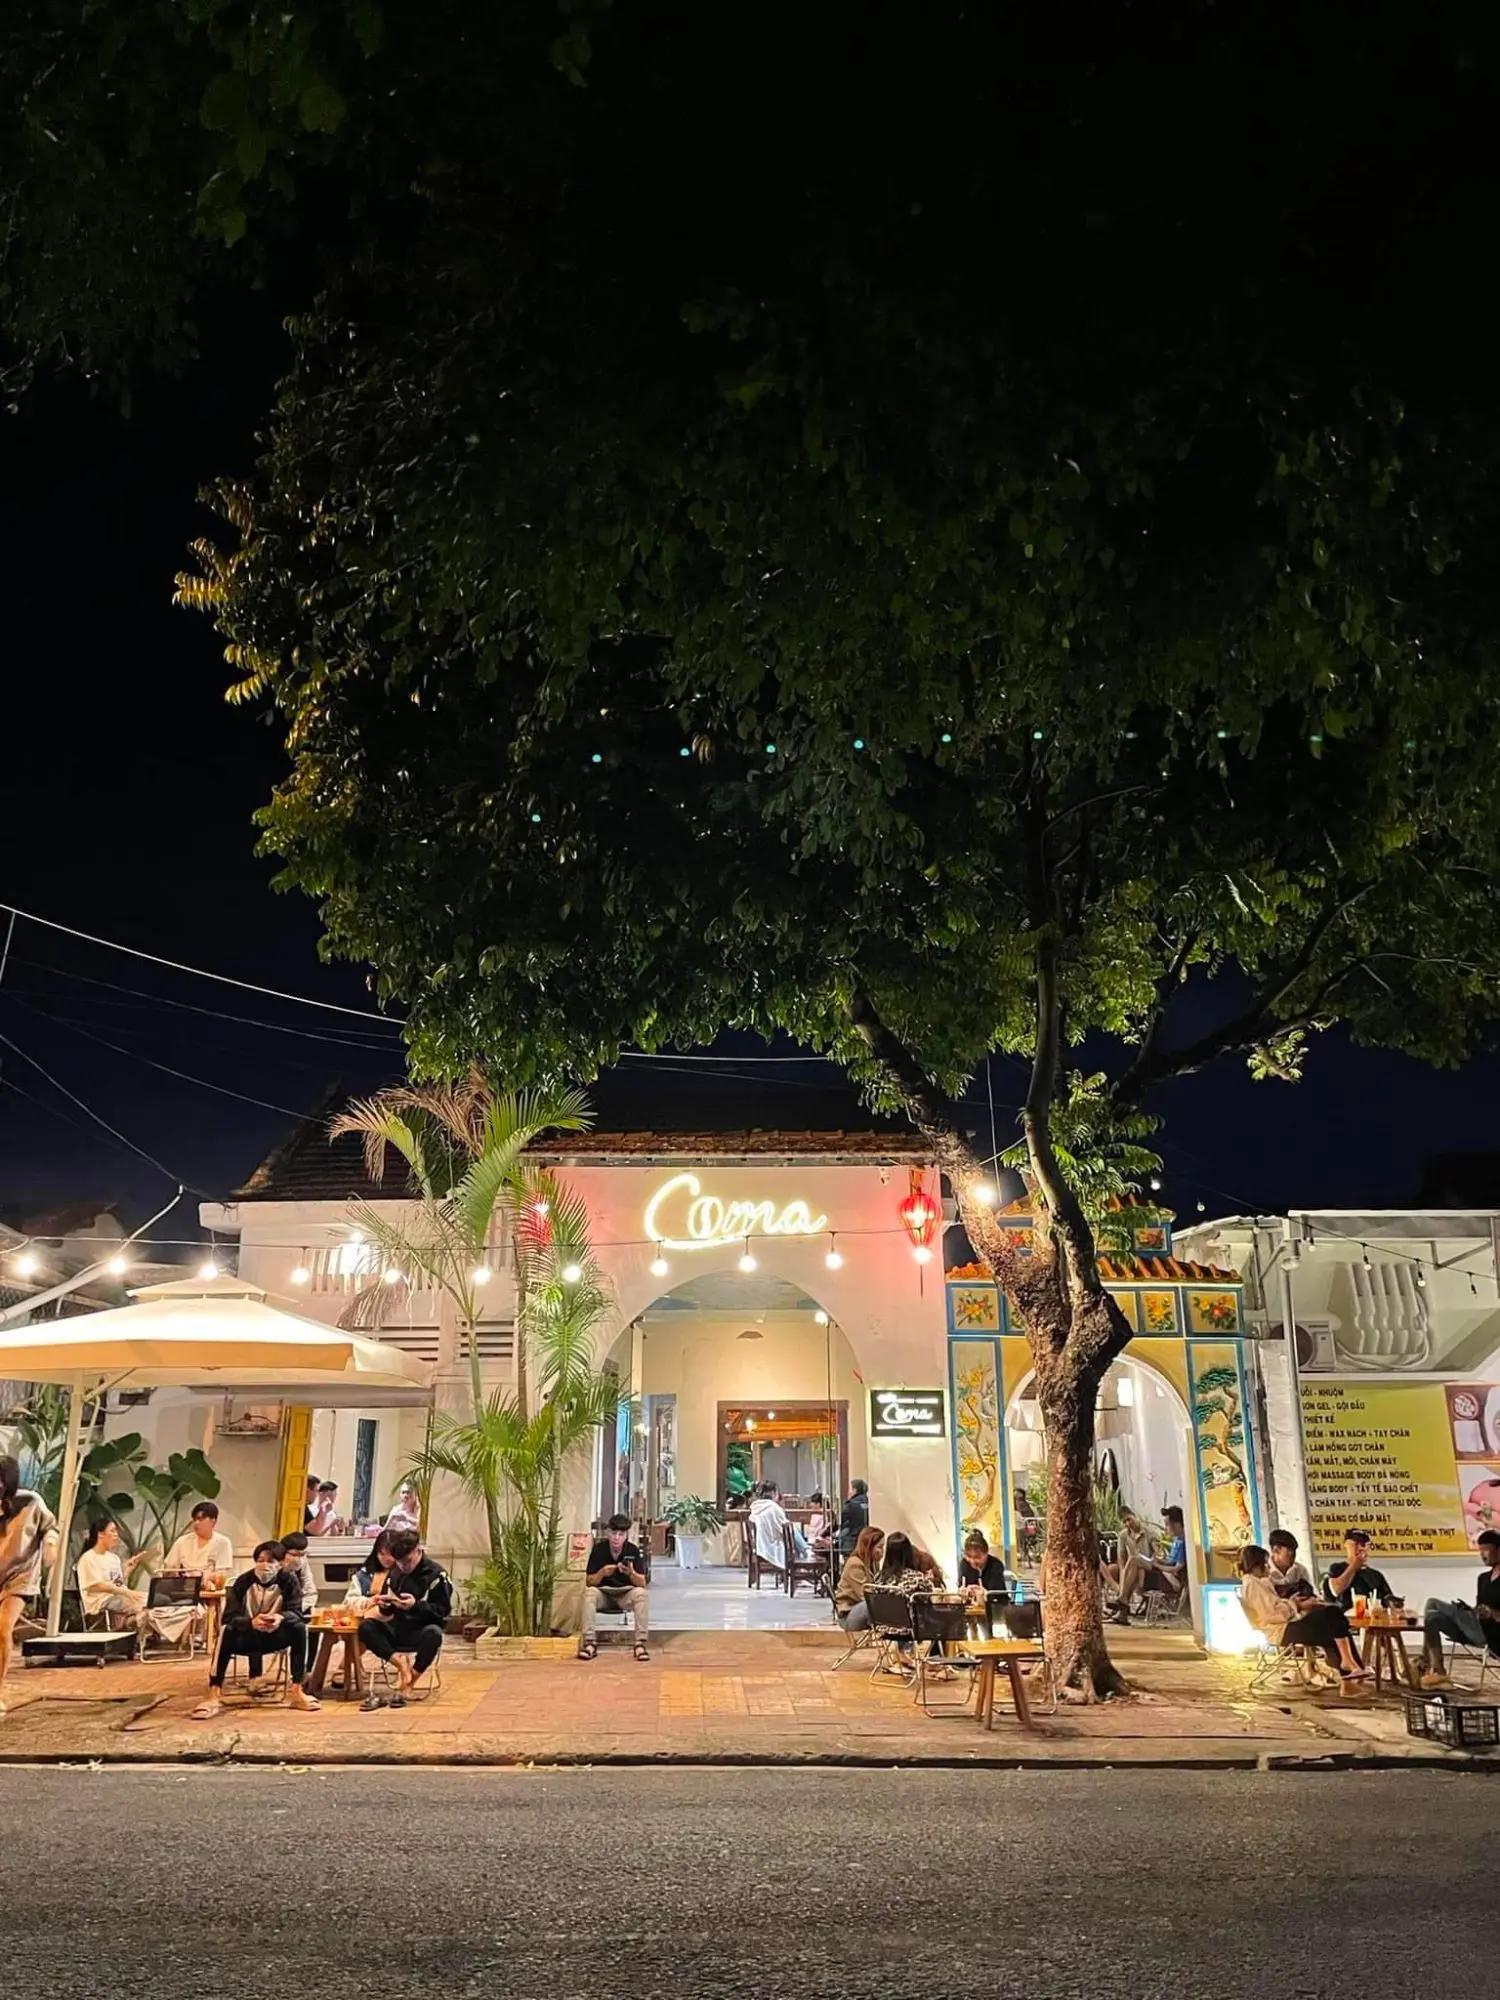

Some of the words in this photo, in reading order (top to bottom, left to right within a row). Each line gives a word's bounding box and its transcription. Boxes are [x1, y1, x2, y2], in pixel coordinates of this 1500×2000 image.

[1321, 1471, 1354, 1479] MASSAGE
[1357, 1471, 1376, 1479] BODY
[1401, 1543, 1416, 1551] KON
[1417, 1542, 1433, 1551] TUM
